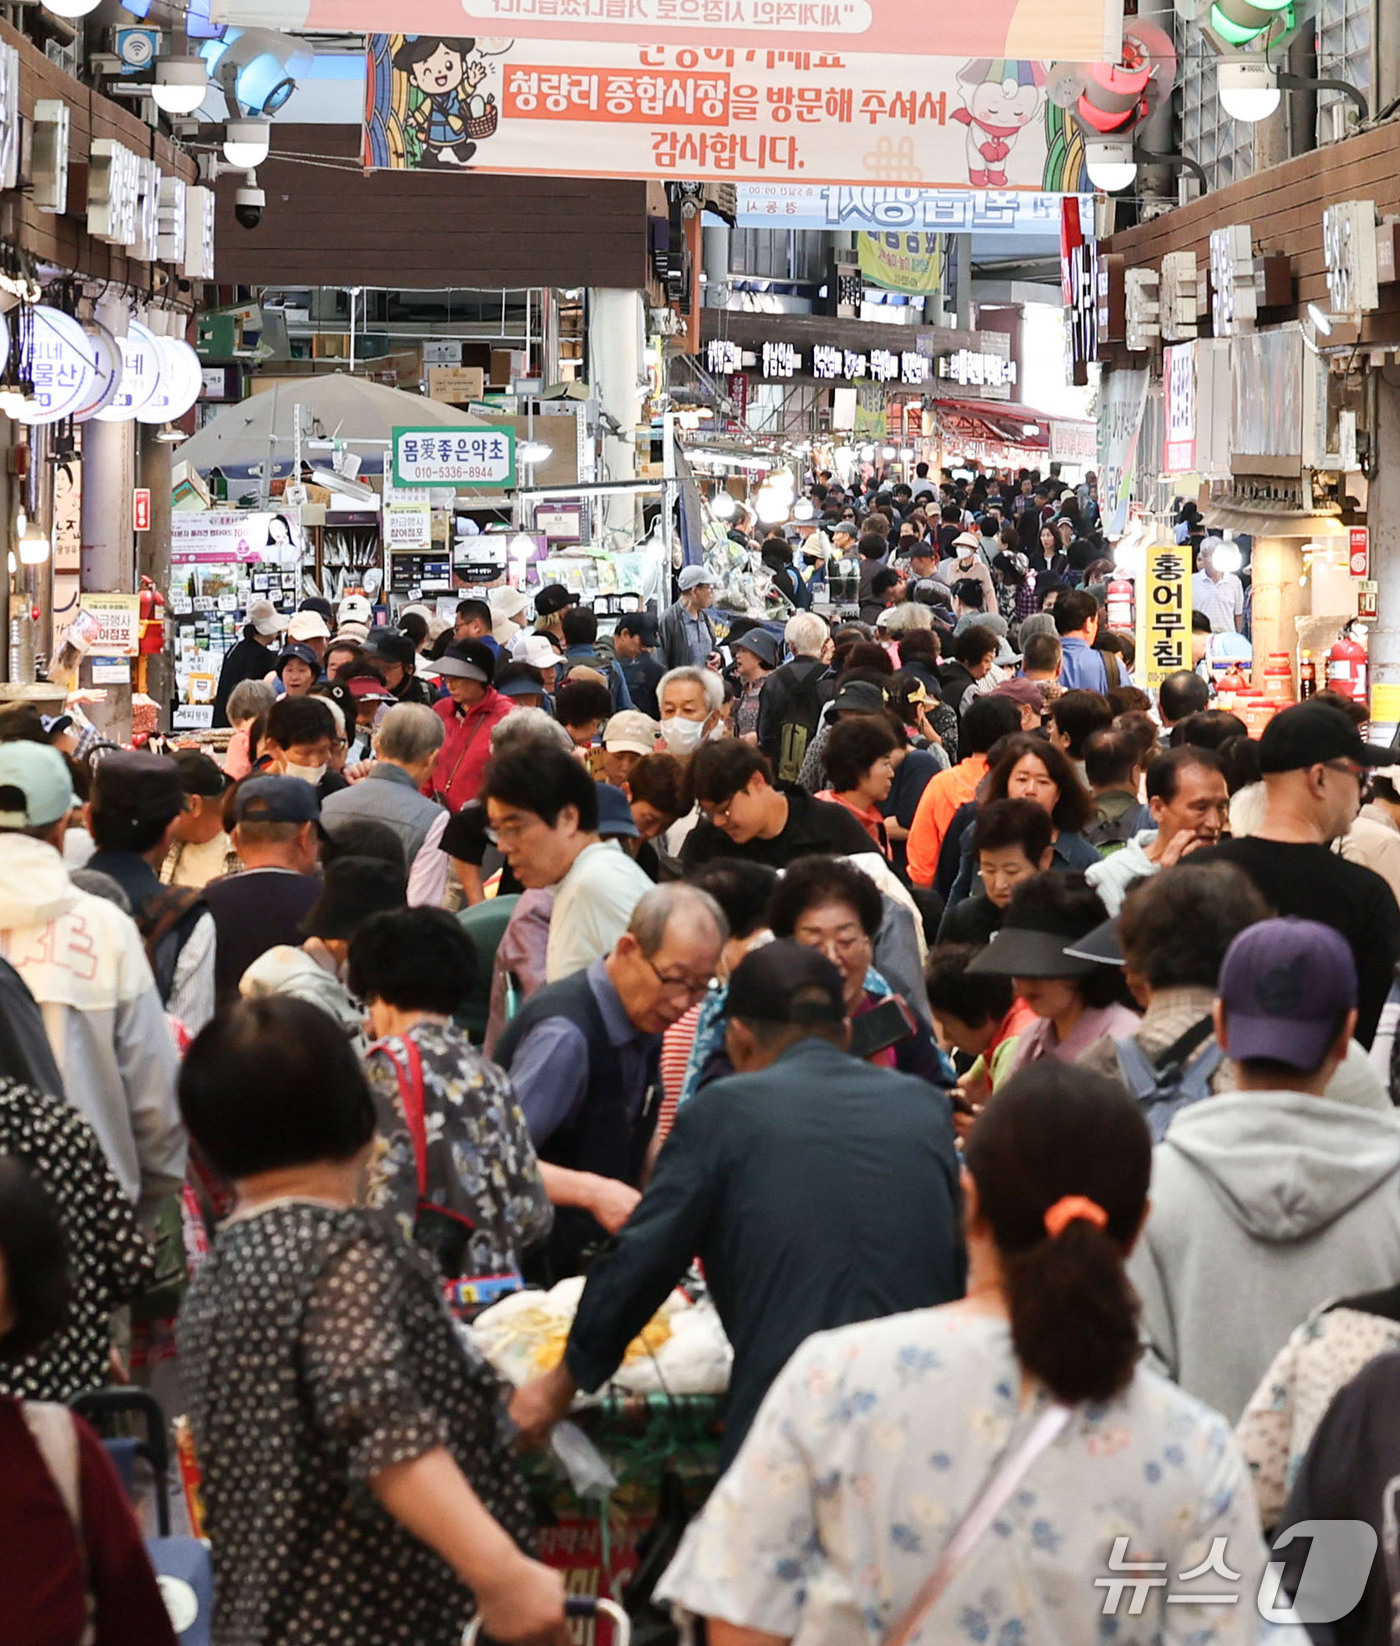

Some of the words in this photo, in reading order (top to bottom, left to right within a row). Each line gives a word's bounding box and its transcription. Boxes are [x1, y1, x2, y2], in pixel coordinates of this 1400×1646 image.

[509, 71, 599, 112] 청량리
[605, 75, 760, 122] 종합시장을
[766, 86, 853, 124] 방문해
[859, 89, 948, 126] 주셔서
[650, 131, 806, 171] 감사합니다.
[403, 438, 504, 463] 몸愛좋은약초
[415, 466, 493, 479] 010-5336-8944
[95, 614, 131, 627] 급행사
[1151, 554, 1186, 667] 홍어무침
